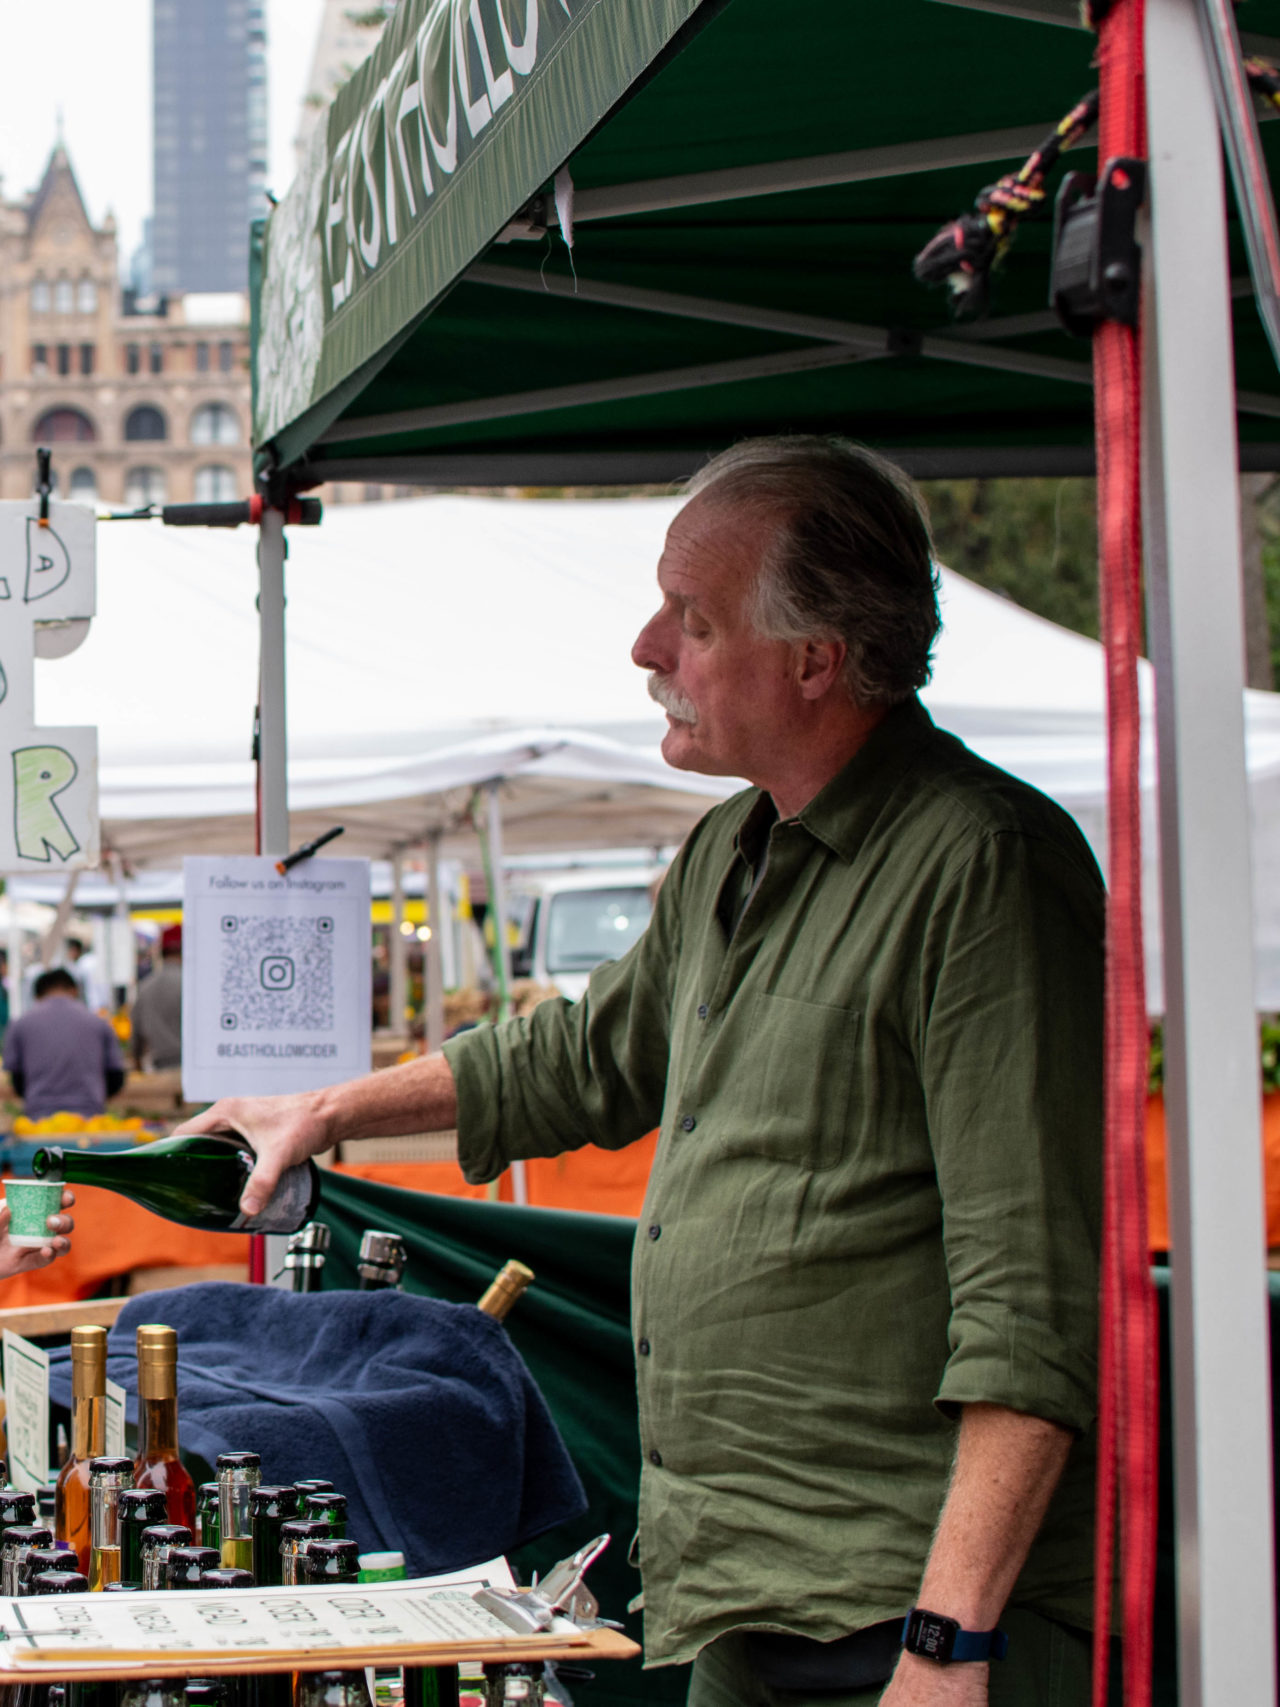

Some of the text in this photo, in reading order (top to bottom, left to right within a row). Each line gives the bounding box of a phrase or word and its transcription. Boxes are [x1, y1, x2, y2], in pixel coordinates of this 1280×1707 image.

[209, 875, 346, 893] Follow us on Instagram
[217, 1043, 339, 1058] @EASTHOLLOWCIDER
